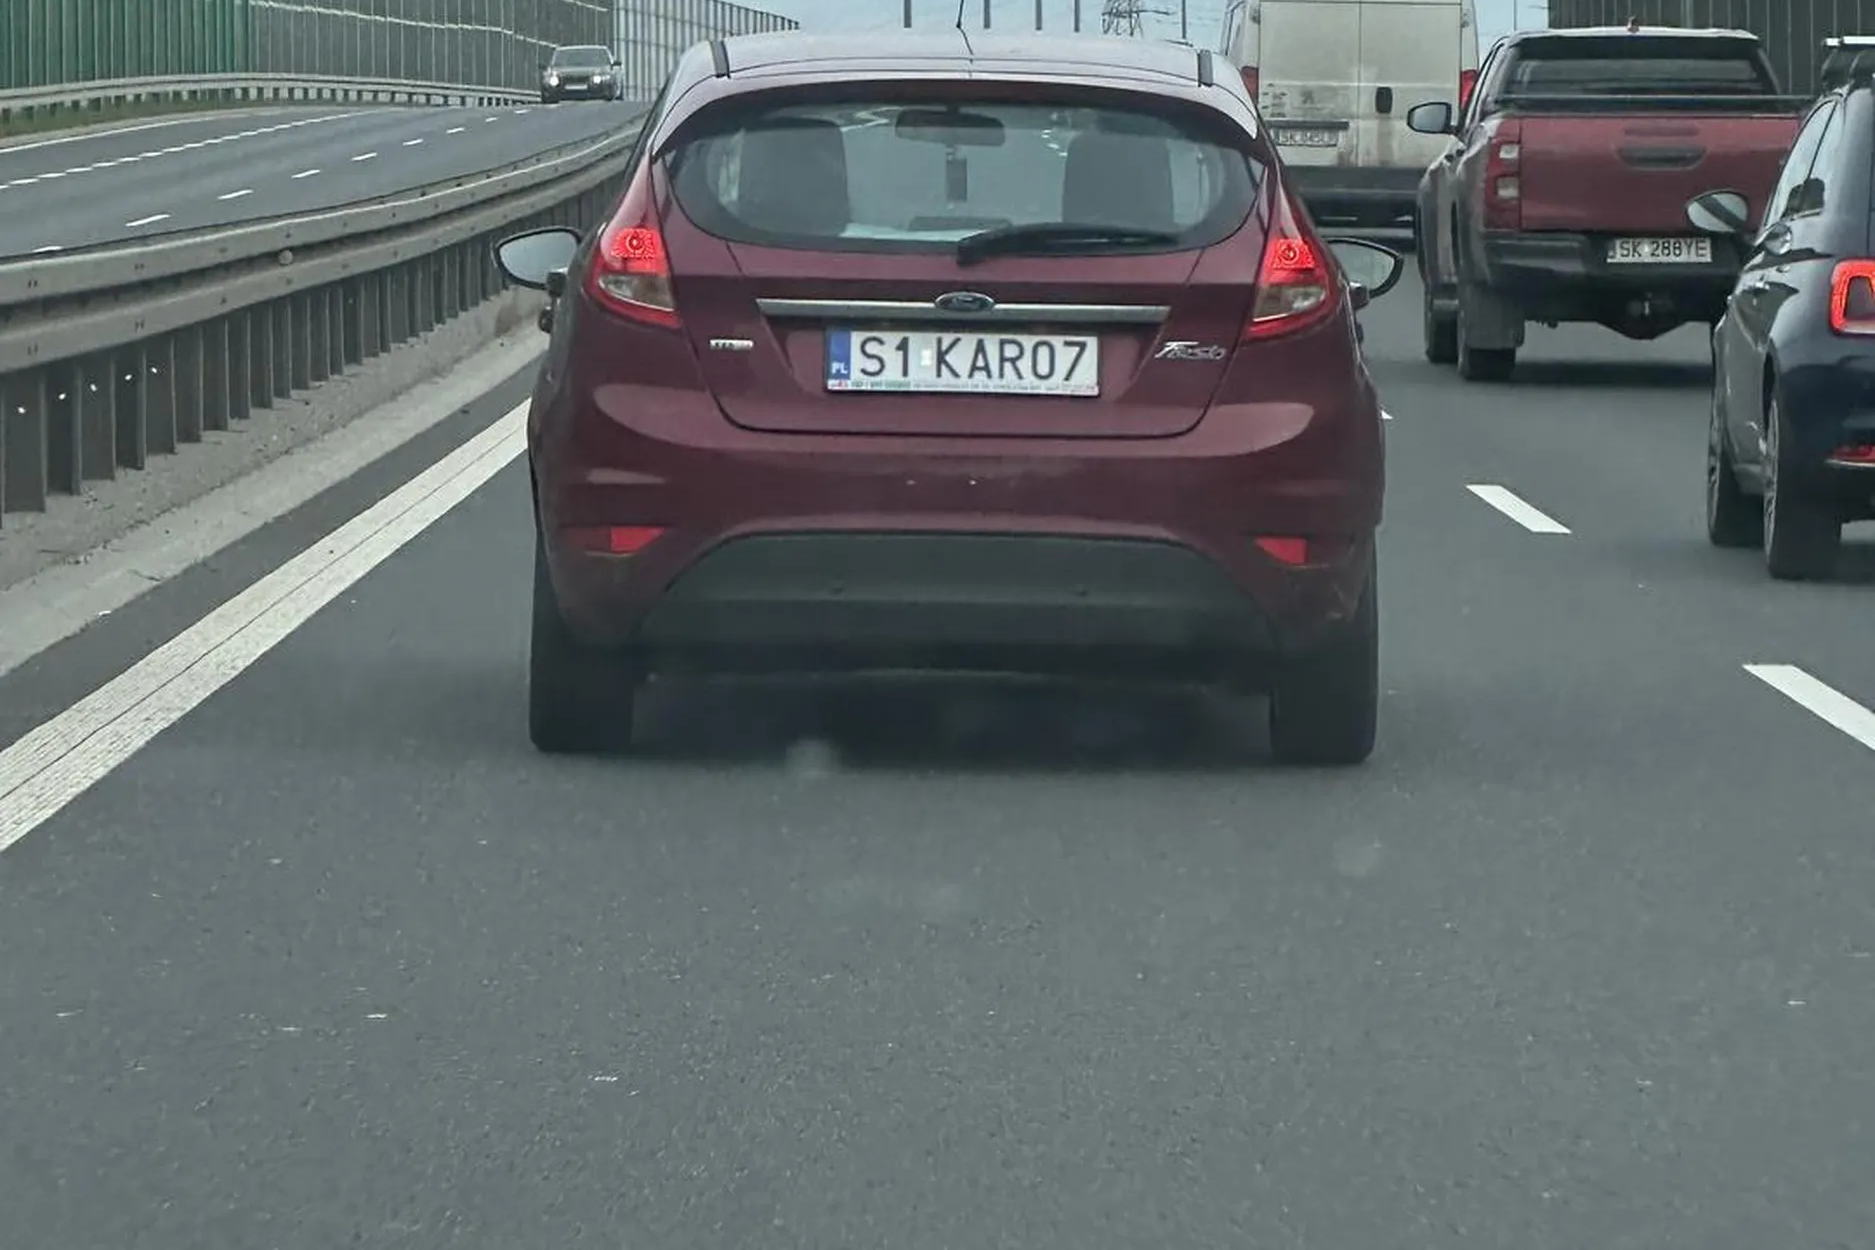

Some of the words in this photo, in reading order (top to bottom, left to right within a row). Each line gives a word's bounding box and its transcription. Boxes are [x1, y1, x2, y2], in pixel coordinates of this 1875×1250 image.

[1619, 240, 1642, 257] SK
[860, 336, 910, 377] S1
[831, 362, 848, 375] PL
